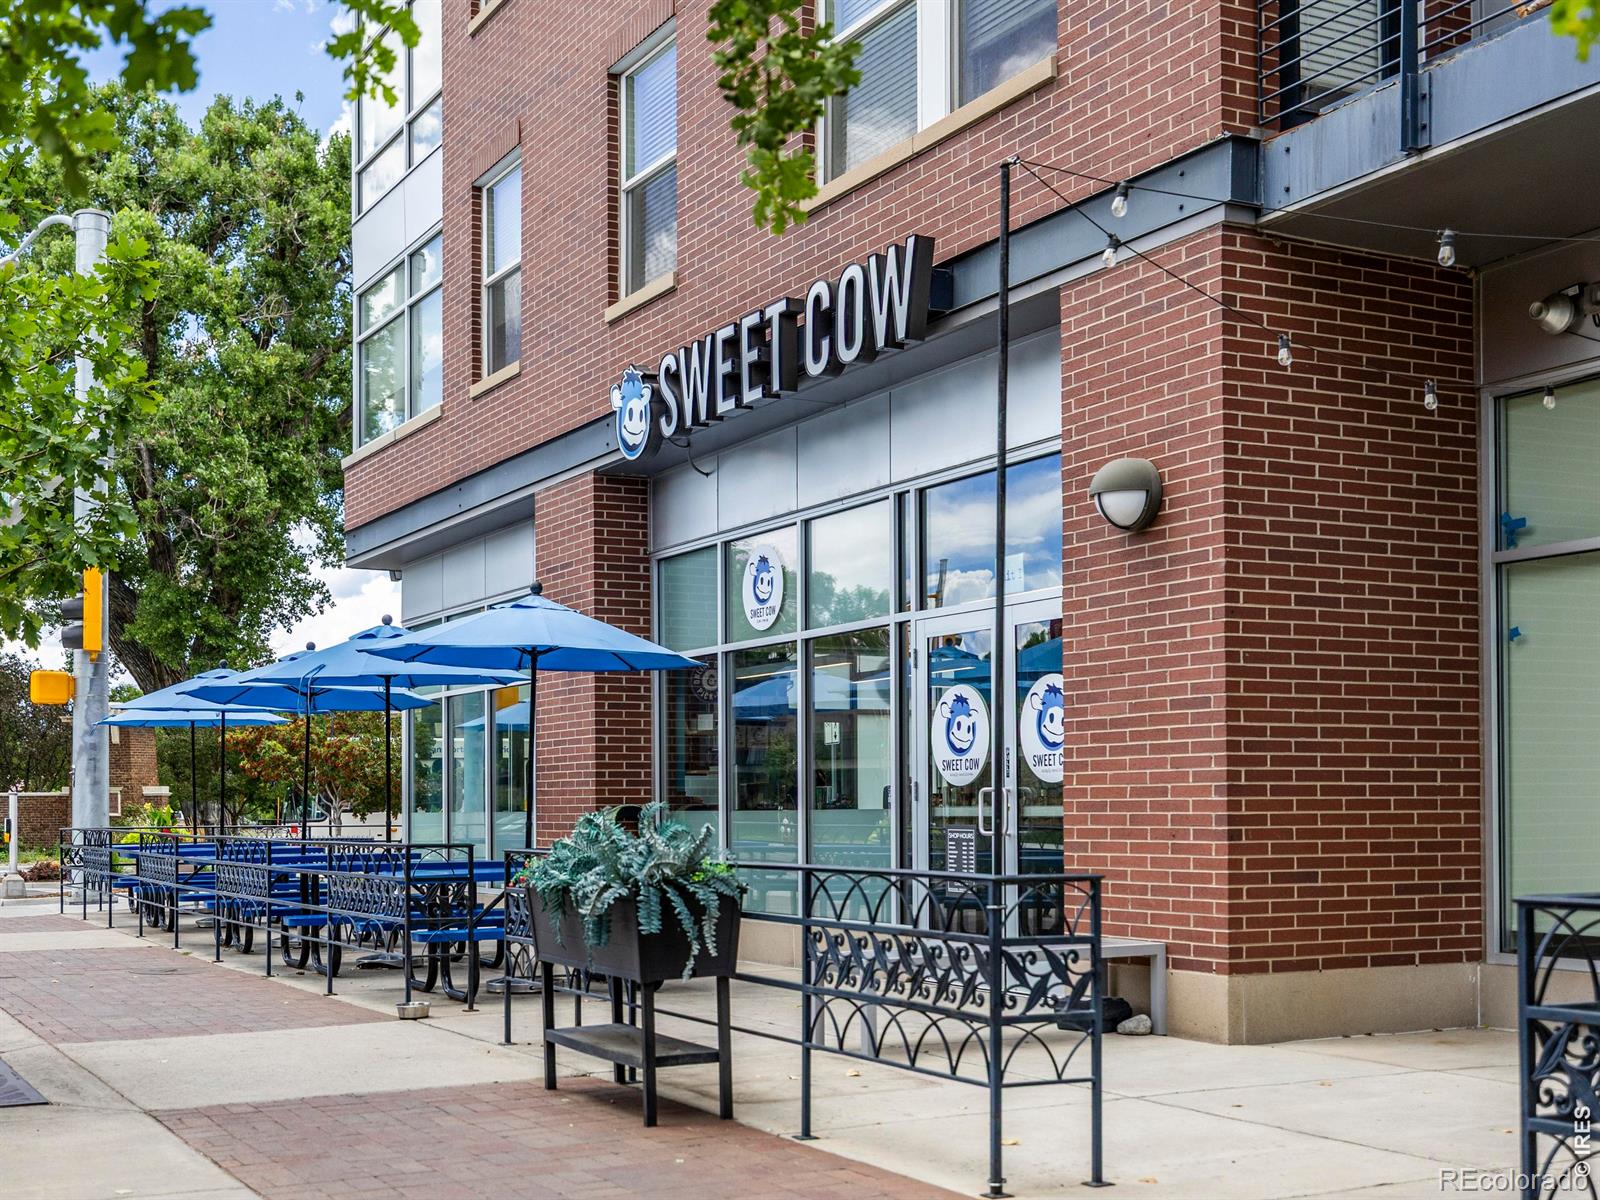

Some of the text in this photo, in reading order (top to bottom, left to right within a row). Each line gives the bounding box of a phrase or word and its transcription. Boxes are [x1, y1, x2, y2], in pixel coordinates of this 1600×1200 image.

[658, 234, 915, 439] SWEET COW
[750, 605, 776, 619] SWEET COW
[942, 757, 980, 772] SWEET COW
[1032, 753, 1057, 768] SWEET
[959, 832, 974, 840] HOURS
